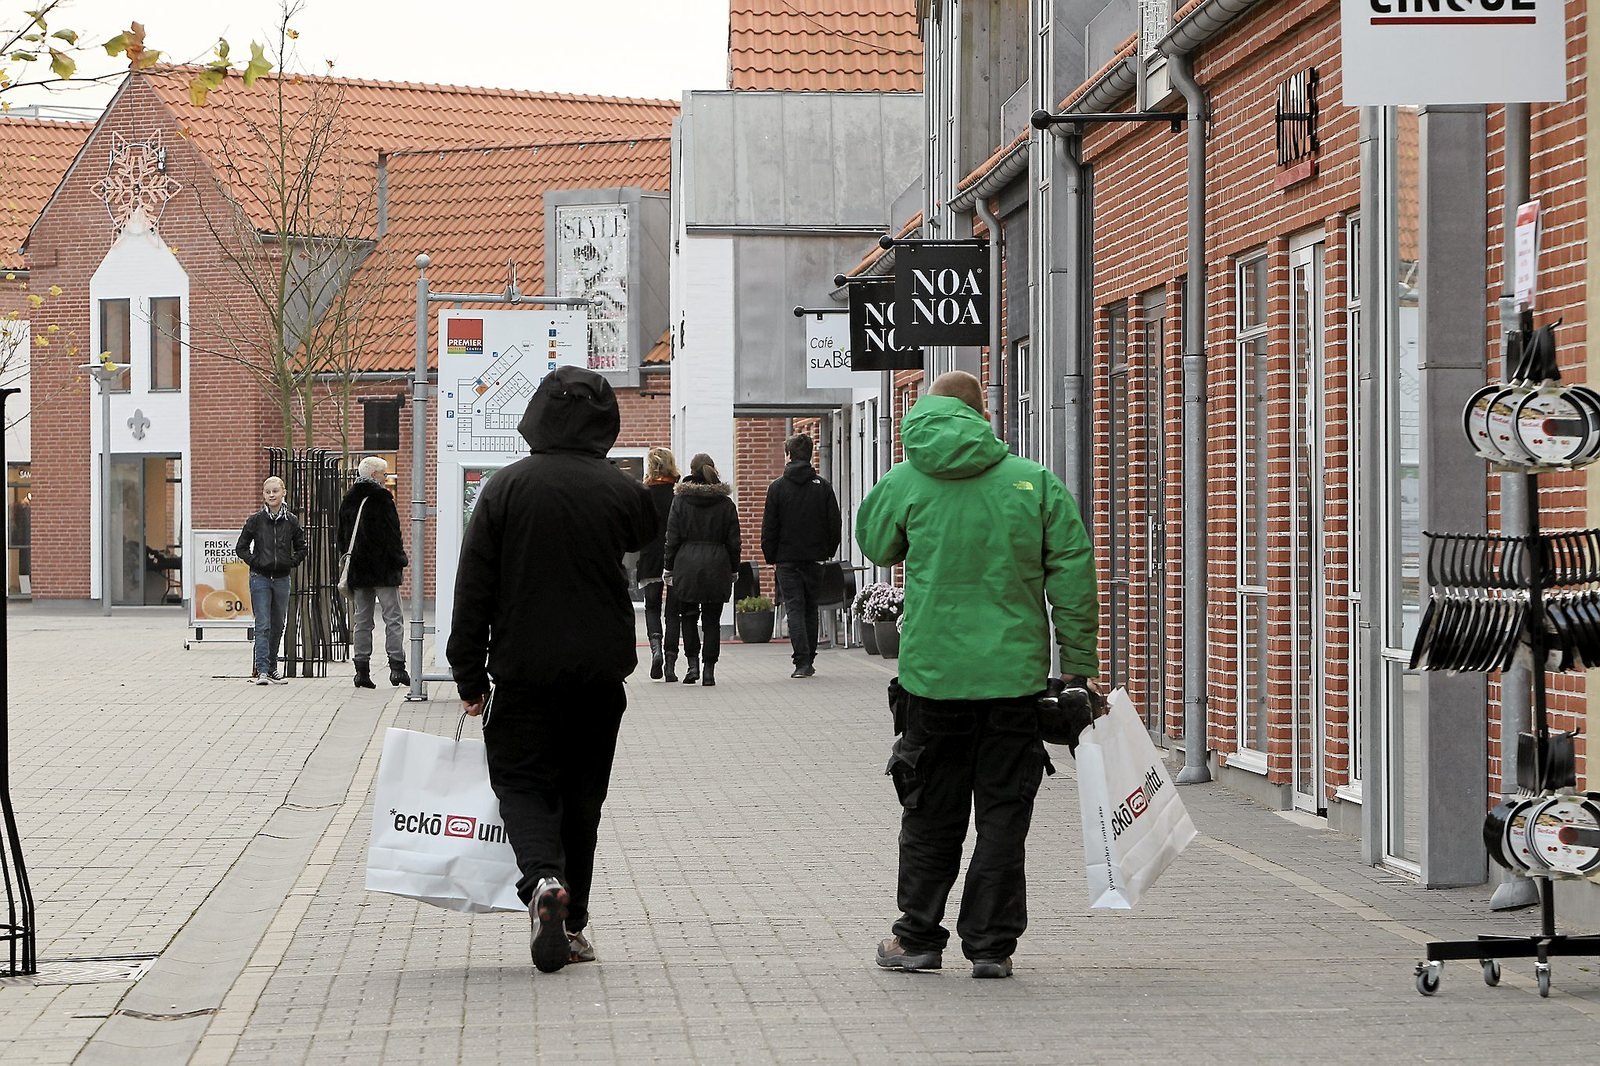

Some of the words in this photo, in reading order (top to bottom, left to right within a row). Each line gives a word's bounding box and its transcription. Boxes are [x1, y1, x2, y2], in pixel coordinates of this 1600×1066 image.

[911, 298, 983, 325] NOA
[448, 339, 482, 347] PREMIER
[810, 336, 834, 349] Café
[204, 540, 232, 548] FRISK-
[204, 549, 236, 557] PRESSE
[204, 565, 227, 573] JUICE
[225, 600, 243, 612] 30
